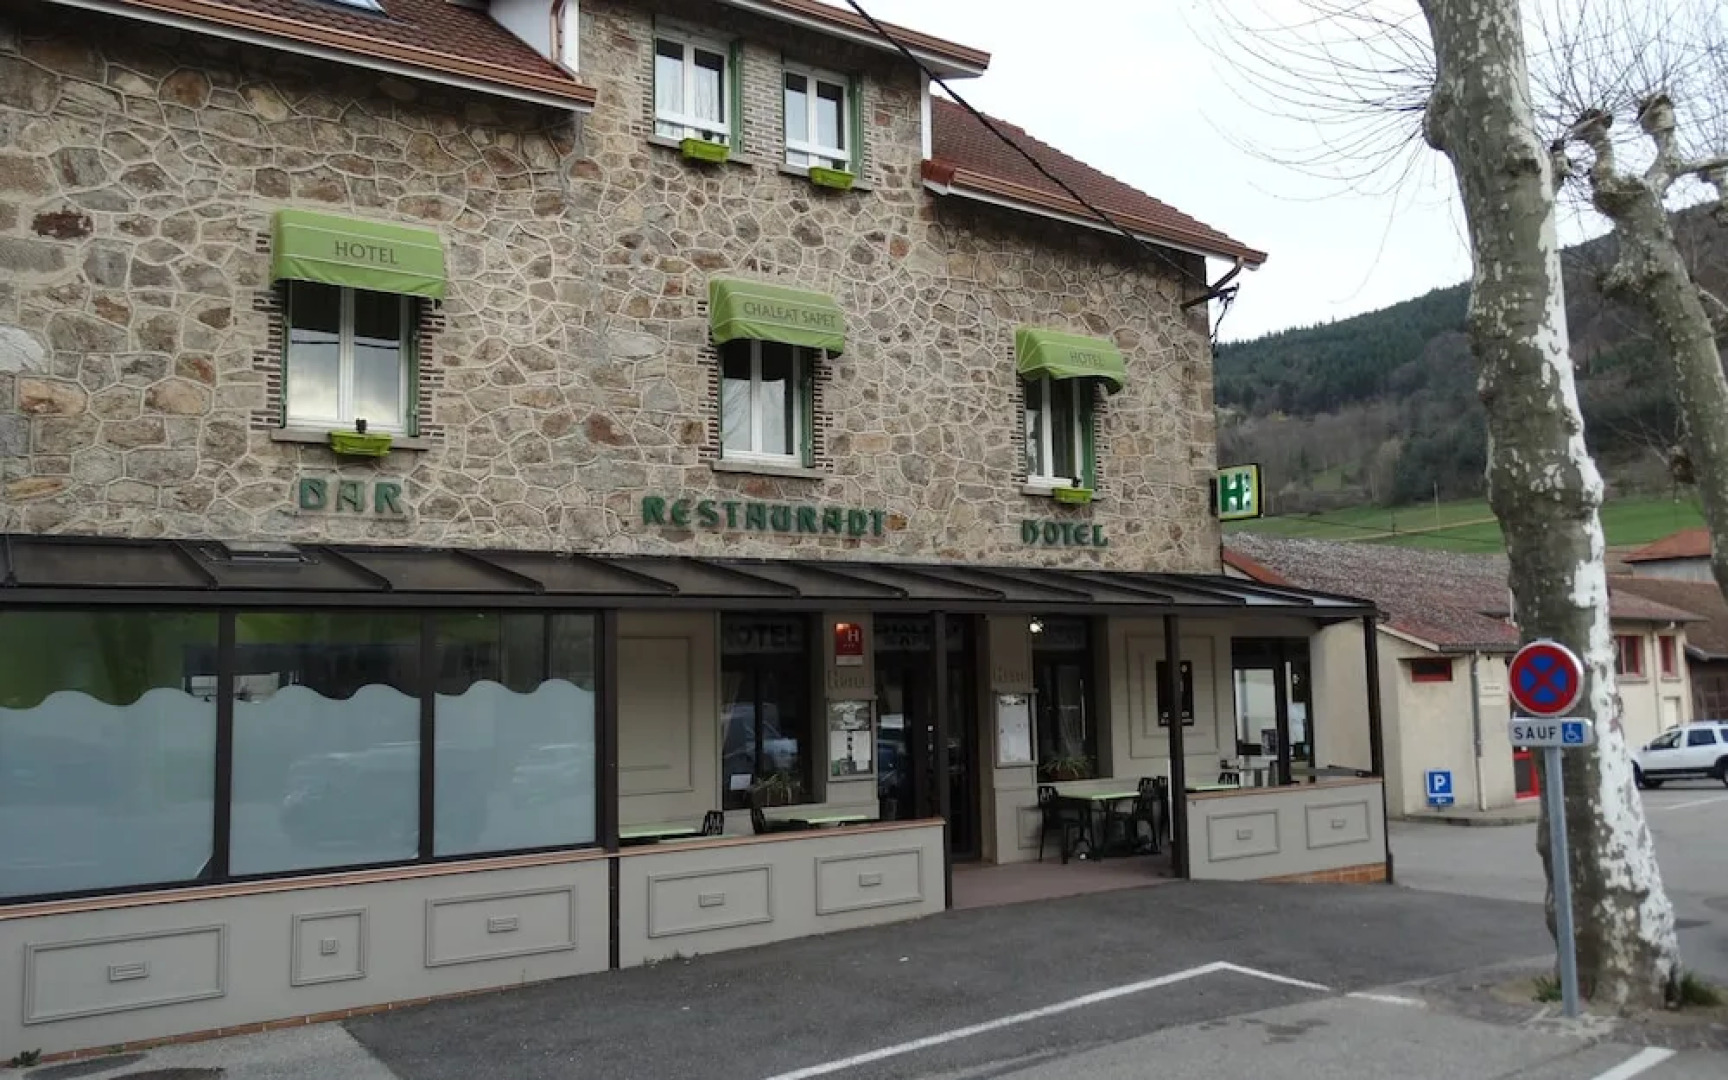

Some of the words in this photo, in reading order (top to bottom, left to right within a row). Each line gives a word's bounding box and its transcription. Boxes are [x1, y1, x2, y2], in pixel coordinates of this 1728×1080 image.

[334, 241, 398, 264] HOTEL
[743, 302, 798, 323] CHALEAT
[801, 310, 836, 328] SAPET
[1069, 350, 1105, 367] HOTEL
[300, 478, 403, 513] BAR
[641, 495, 887, 537] RESTAURANT
[1022, 519, 1109, 547] HOTEL
[847, 629, 860, 642] H
[1513, 725, 1557, 740] SAUF
[1433, 773, 1447, 791] P
